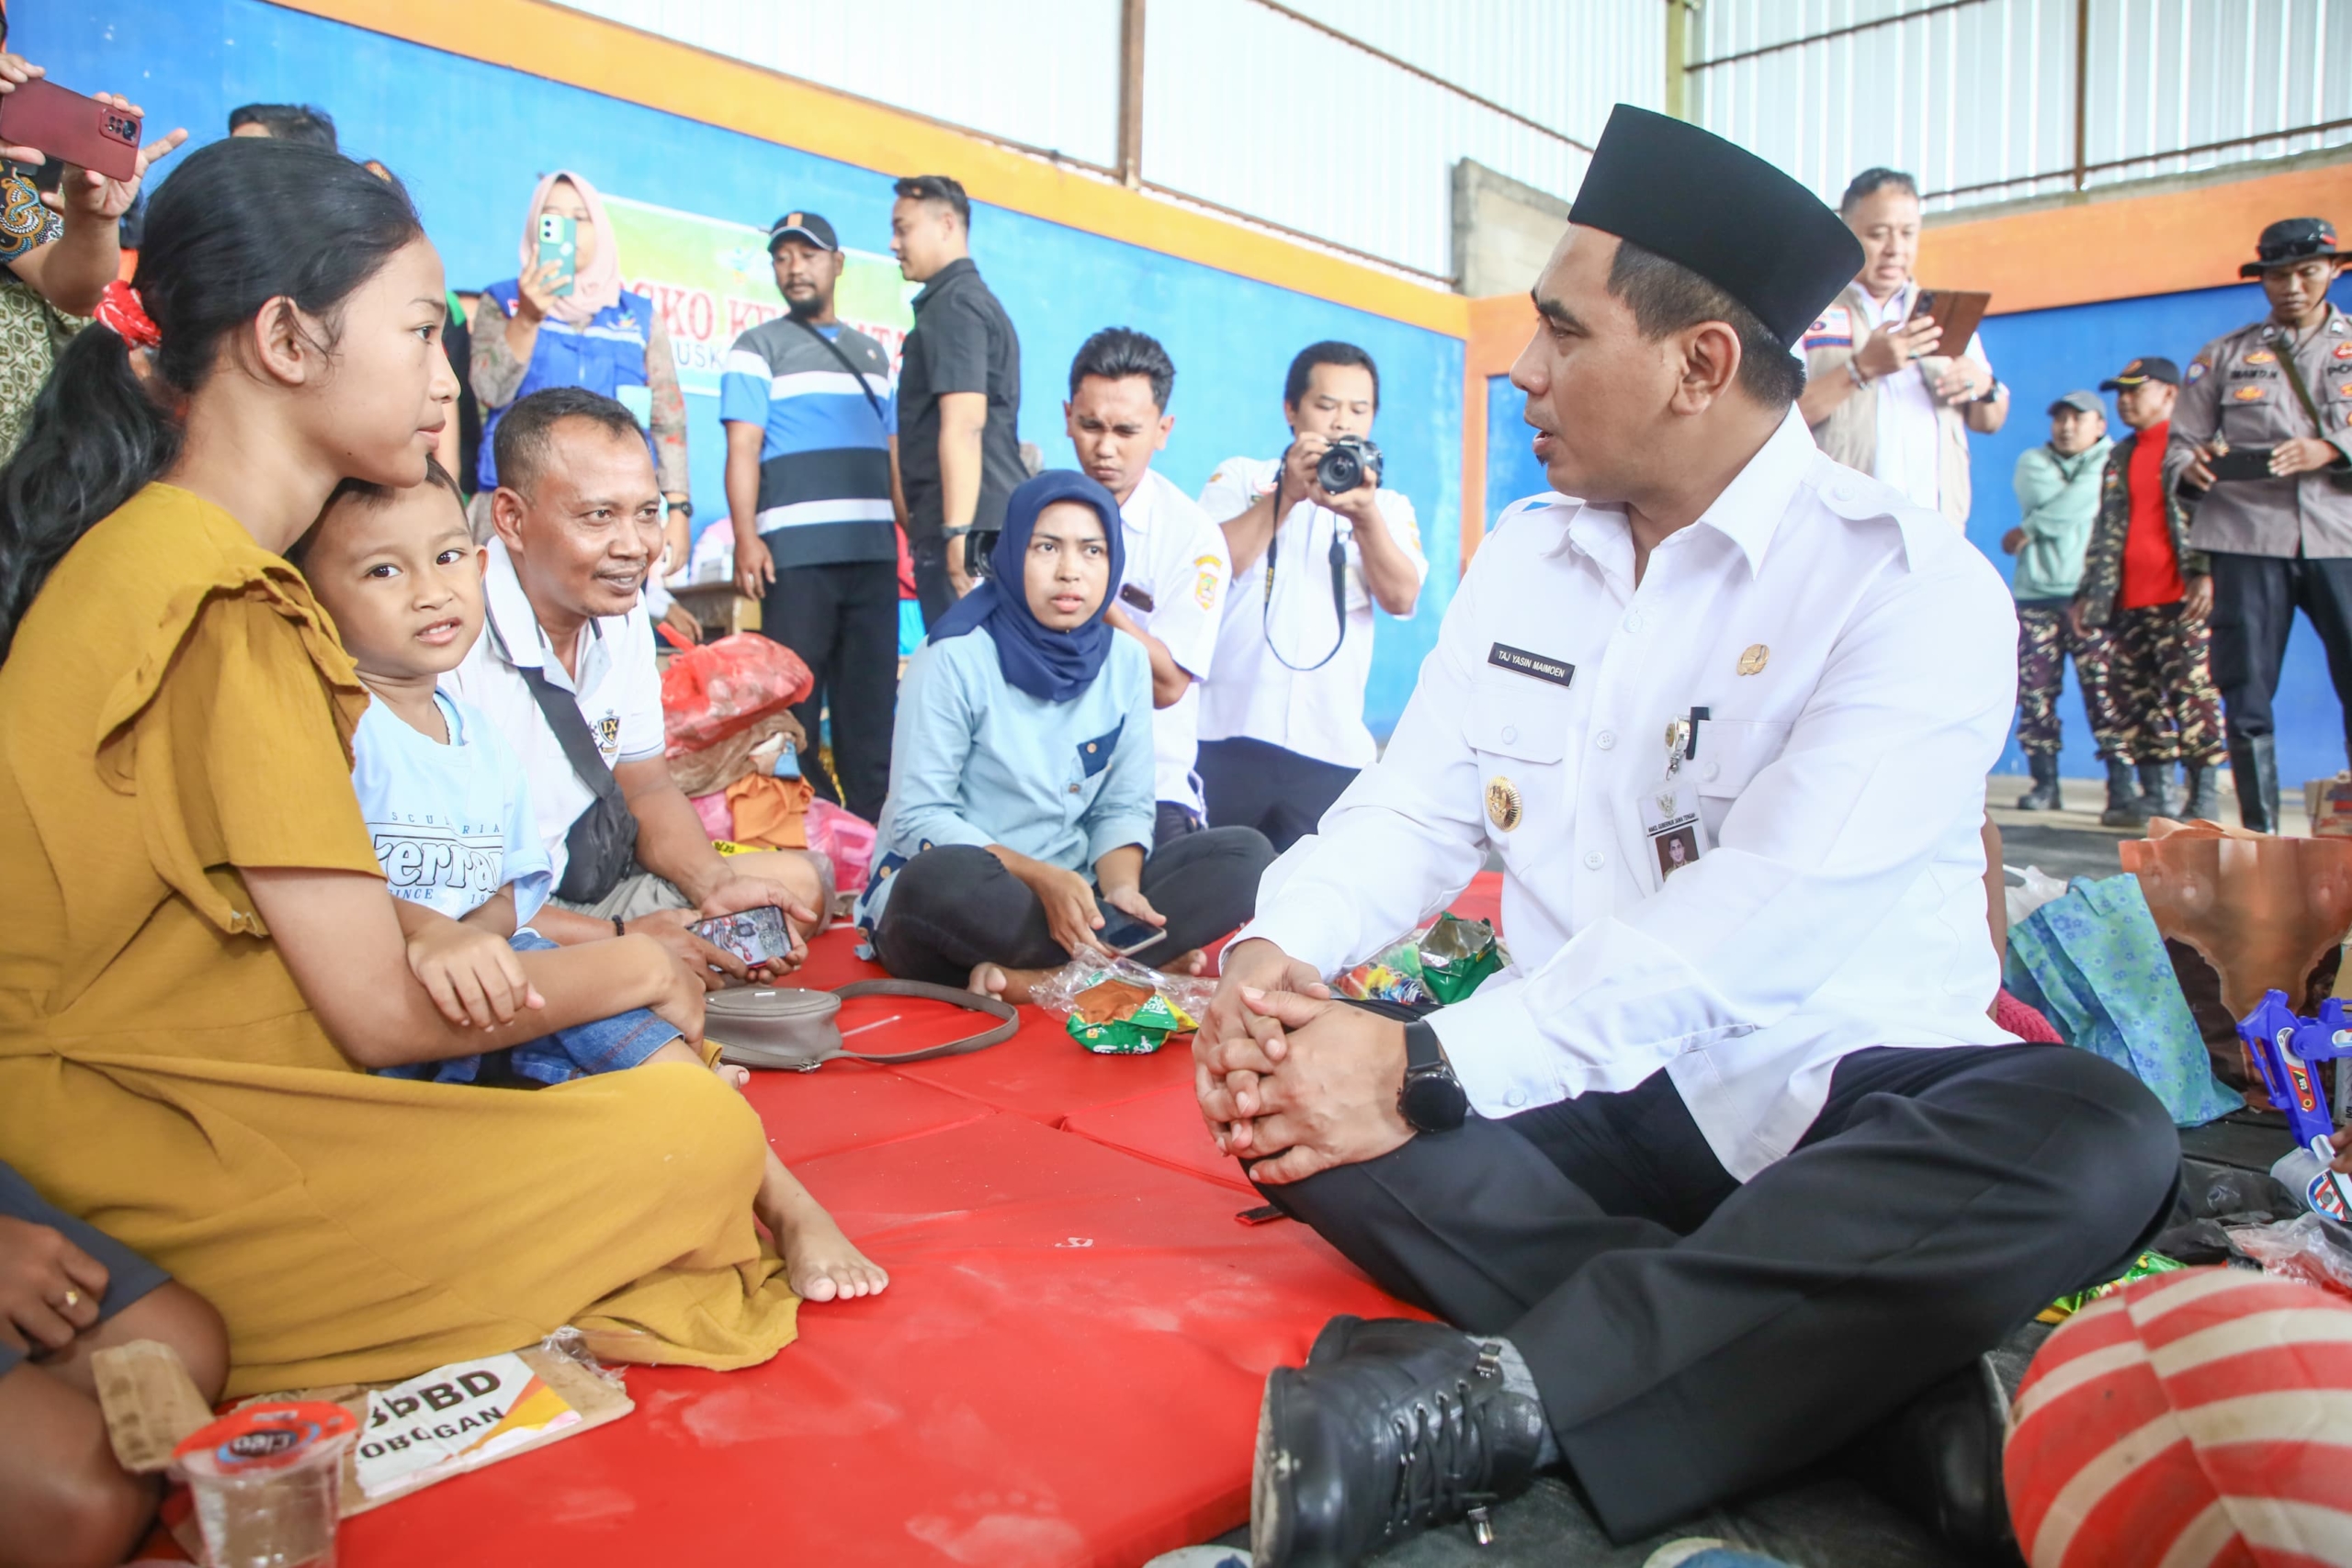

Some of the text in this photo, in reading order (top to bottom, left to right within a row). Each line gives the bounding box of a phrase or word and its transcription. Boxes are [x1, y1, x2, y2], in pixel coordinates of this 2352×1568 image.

[1498, 650, 1566, 678] TAJ YASIN MAIMOEN
[391, 811, 501, 834] SCURIA
